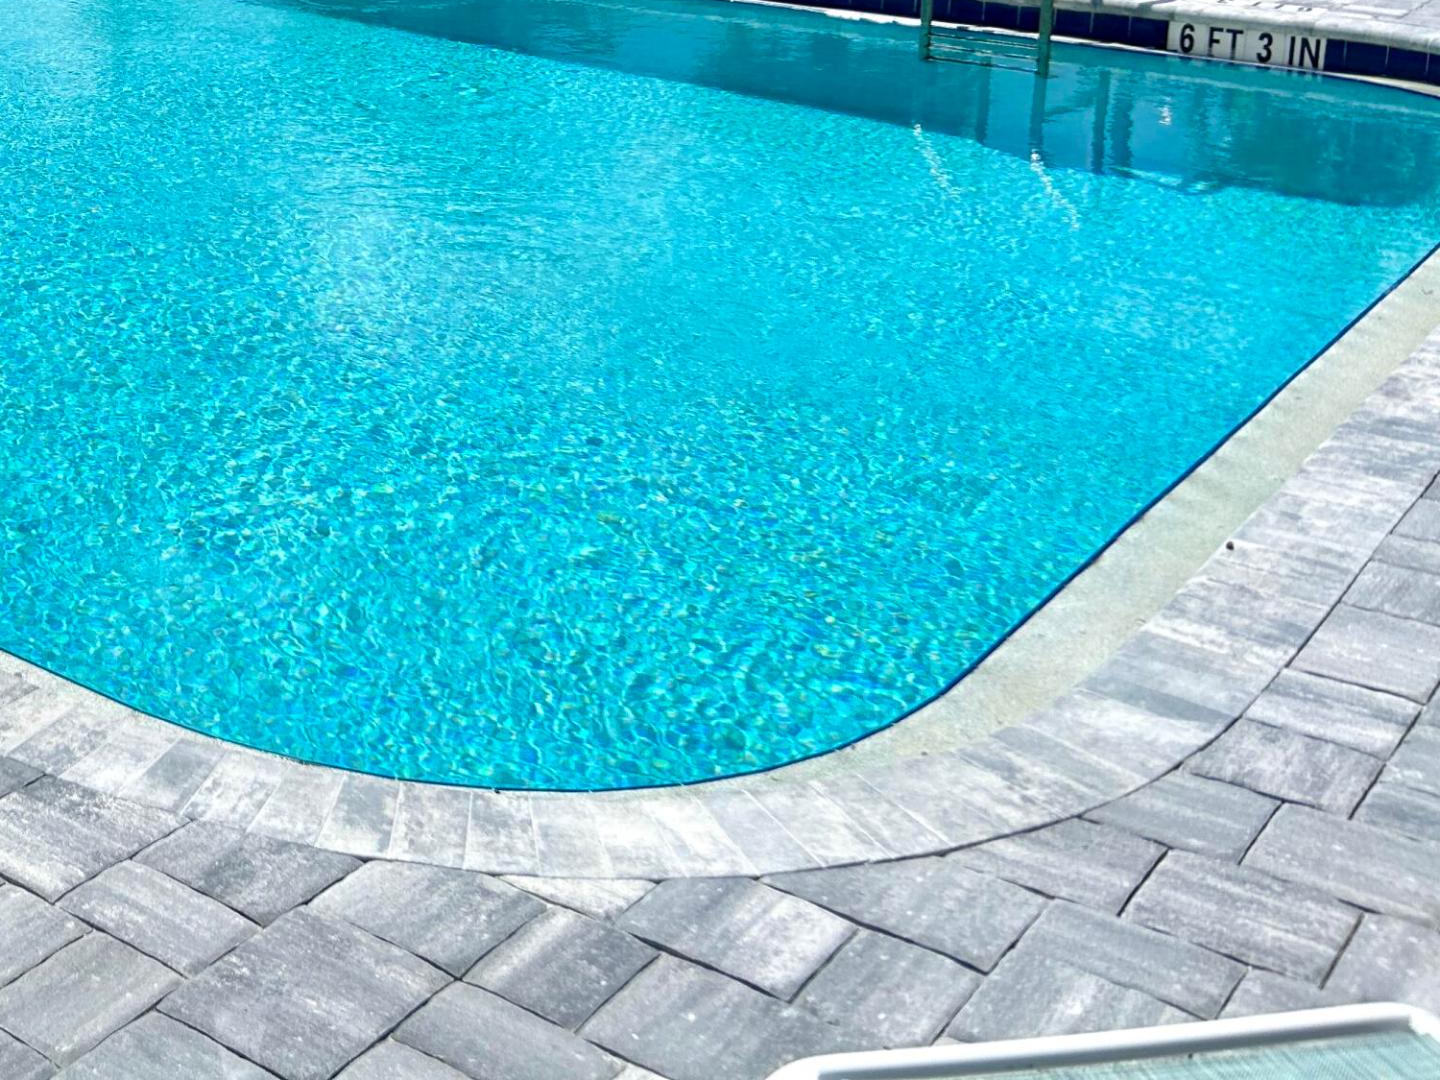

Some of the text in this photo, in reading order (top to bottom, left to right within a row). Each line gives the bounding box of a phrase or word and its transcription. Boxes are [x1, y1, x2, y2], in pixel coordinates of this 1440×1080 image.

[1180, 23, 1321, 68] 6 FT 3 IN
